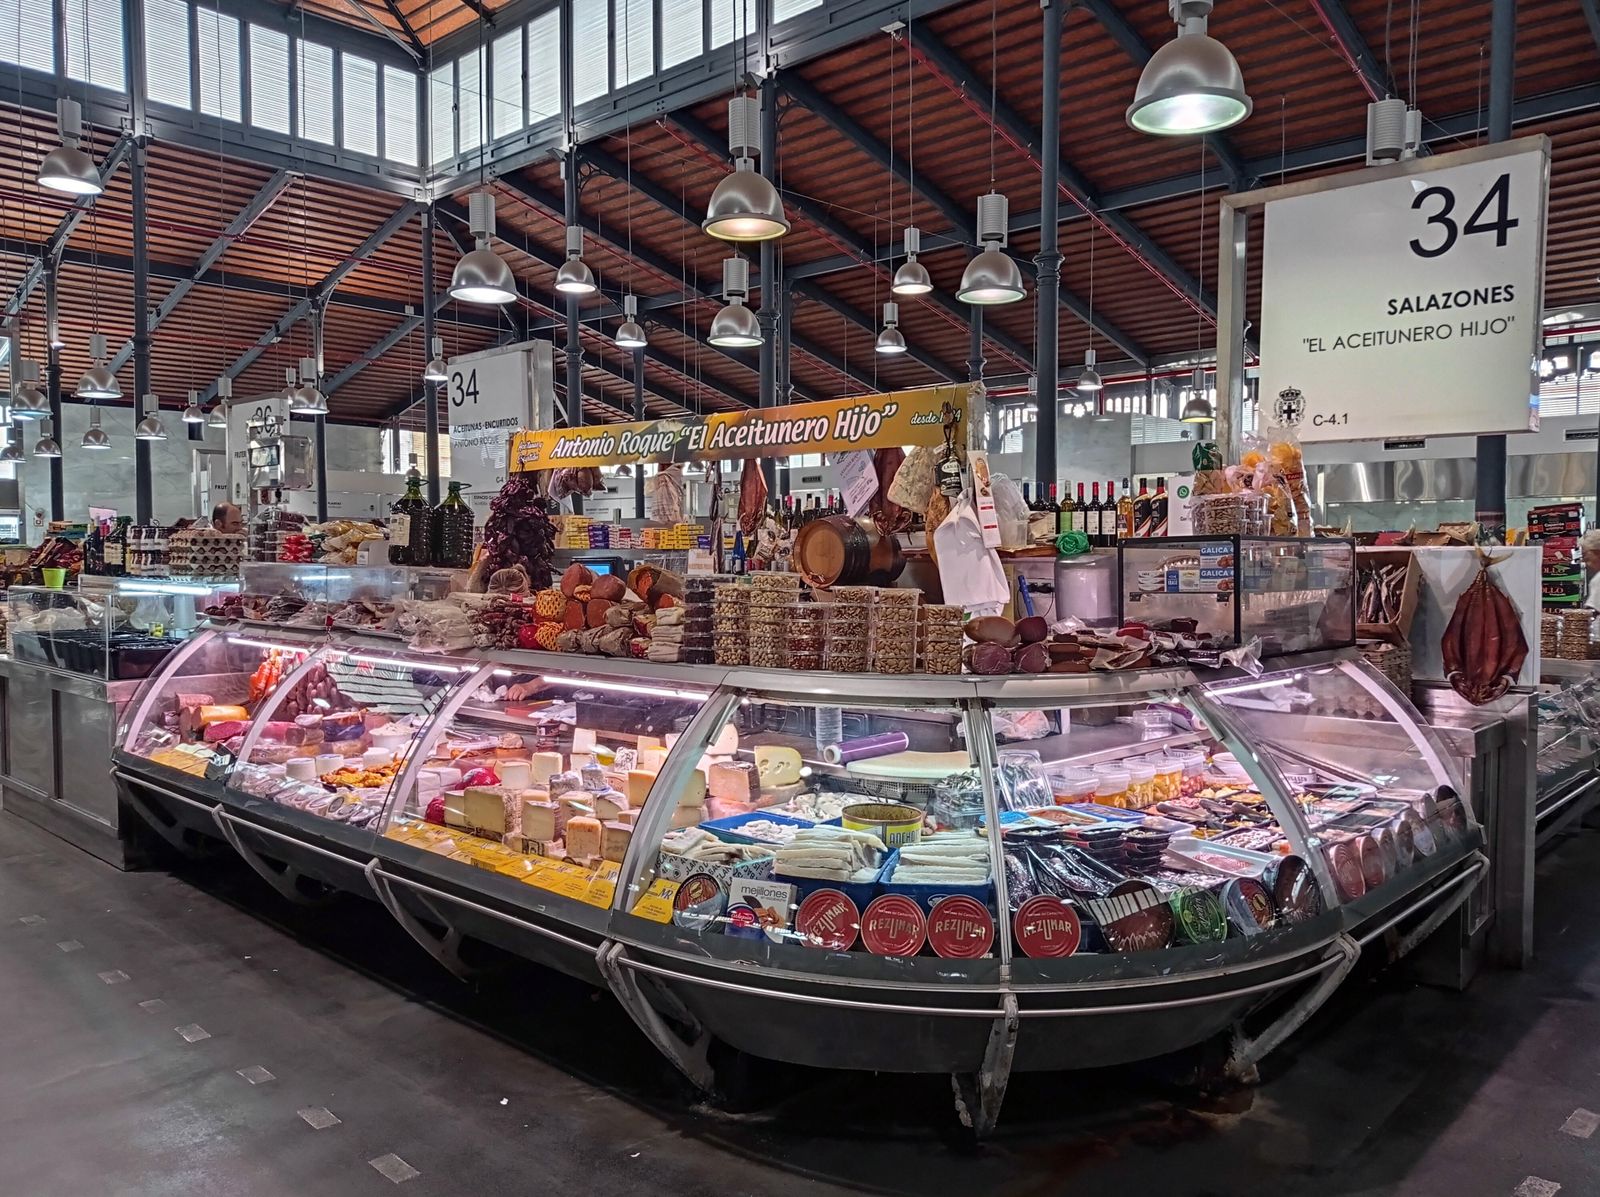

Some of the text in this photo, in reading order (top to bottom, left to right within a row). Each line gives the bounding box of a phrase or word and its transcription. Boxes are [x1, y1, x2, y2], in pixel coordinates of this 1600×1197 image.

[1409, 173, 1519, 258] 34
[1387, 284, 1515, 316] SALAZONES
[1332, 323, 1453, 351] ACEITUNERO
[1460, 315, 1516, 338] HIJO"
[451, 368, 480, 407] 34
[910, 410, 939, 425] desde
[1312, 412, 1349, 427] C-4.1
[550, 430, 615, 459] Antonio
[617, 430, 674, 457] Roque
[711, 417, 828, 448] Aceitunero
[740, 886, 788, 899] mejillones
[868, 918, 921, 940] REZUMAR
[935, 918, 987, 941] REZUMAR
[1023, 919, 1073, 941] REZUMAR
